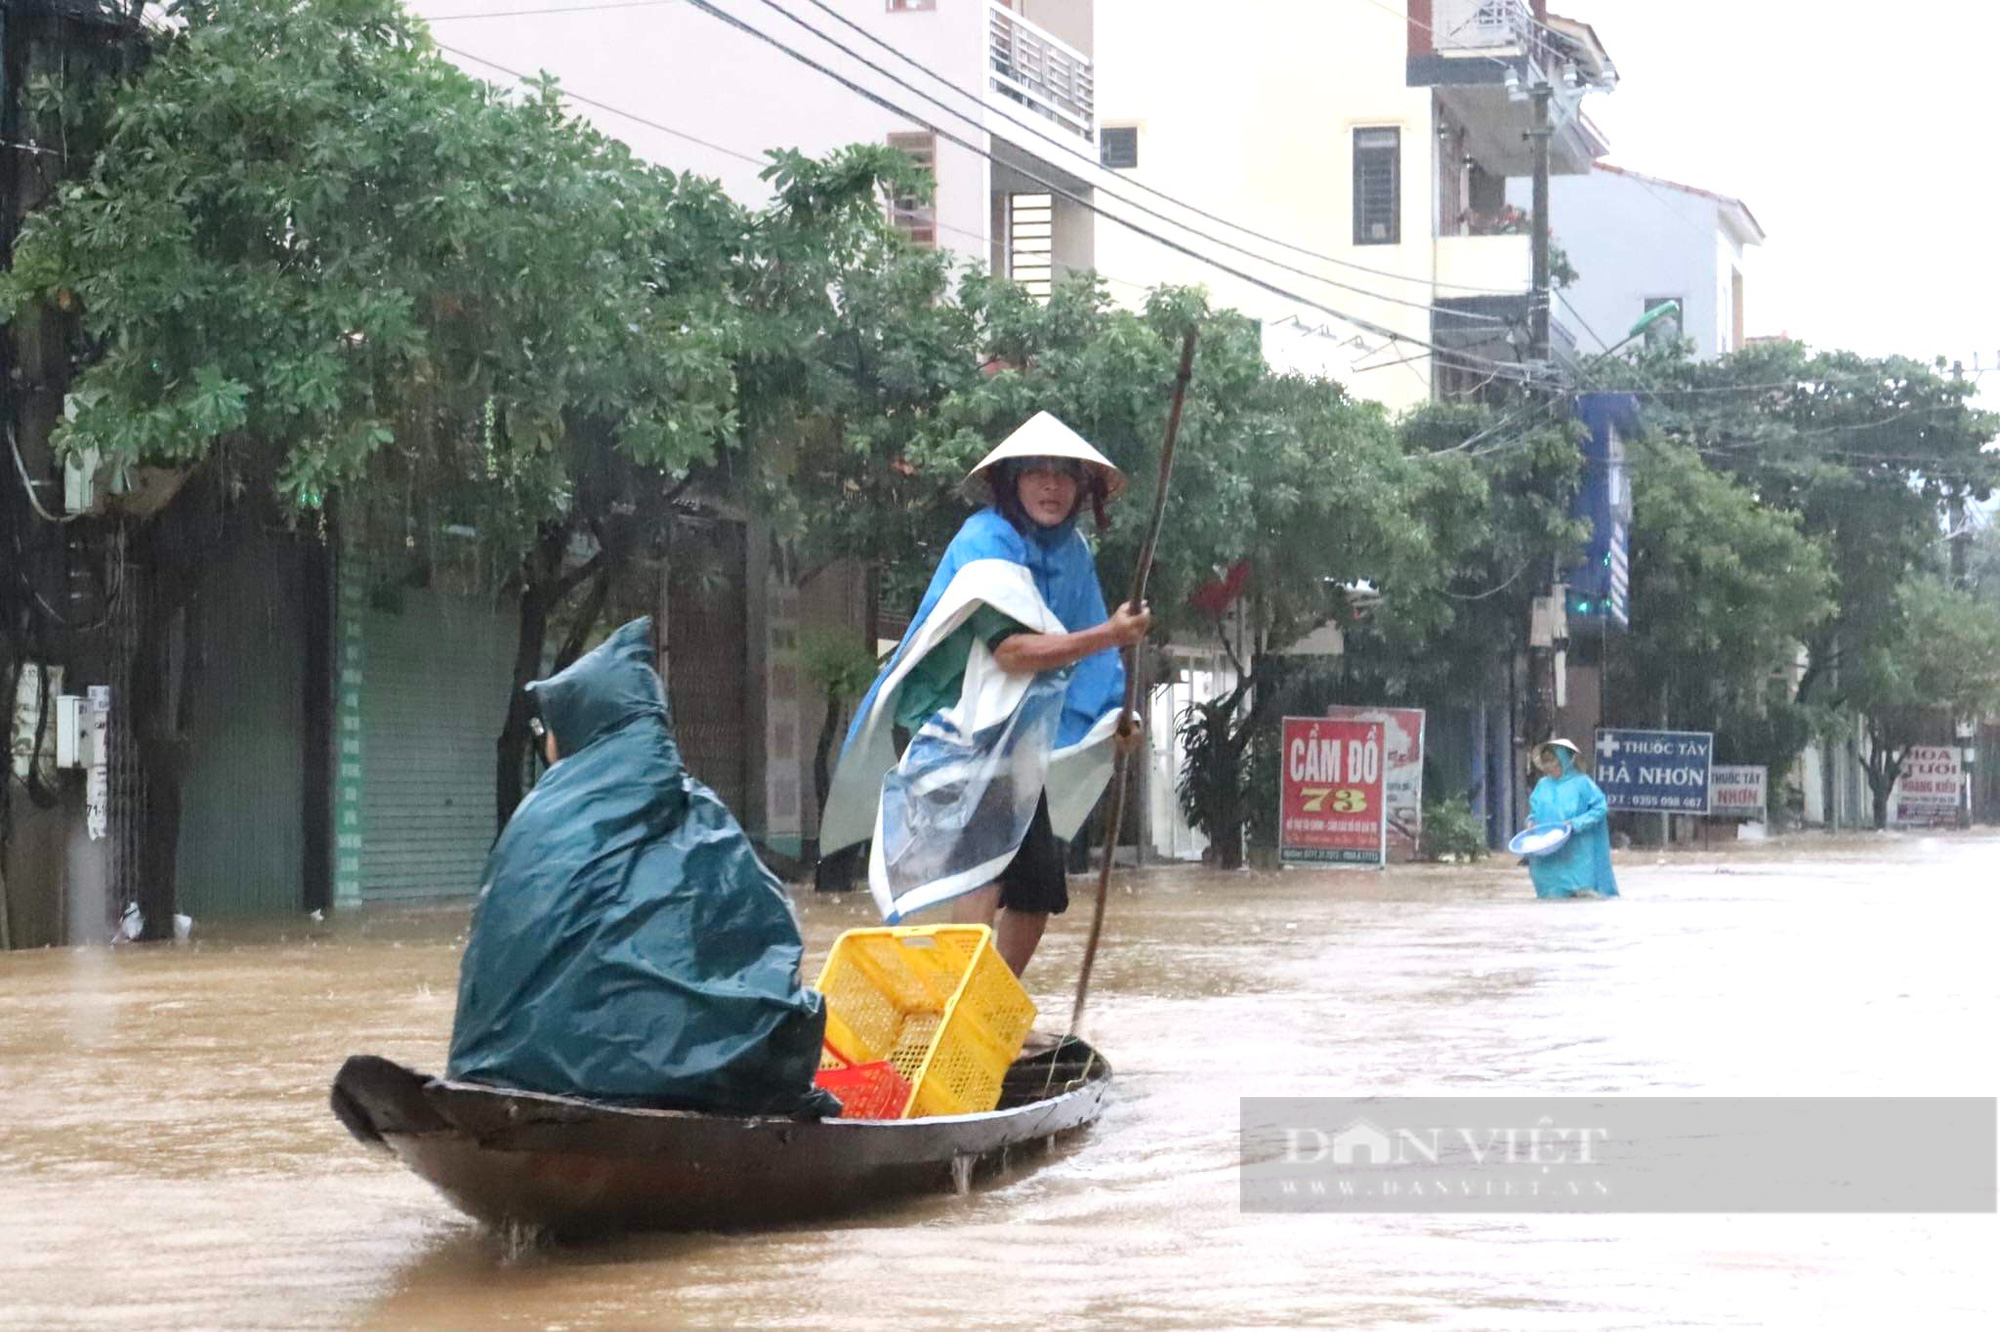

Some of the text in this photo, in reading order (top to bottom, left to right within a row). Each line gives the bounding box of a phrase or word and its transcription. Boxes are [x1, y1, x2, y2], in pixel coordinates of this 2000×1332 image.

[1624, 737, 1708, 756] THUỐC TÂY
[1639, 765, 1704, 786] NHƠN
[1300, 787, 1367, 813] 73
